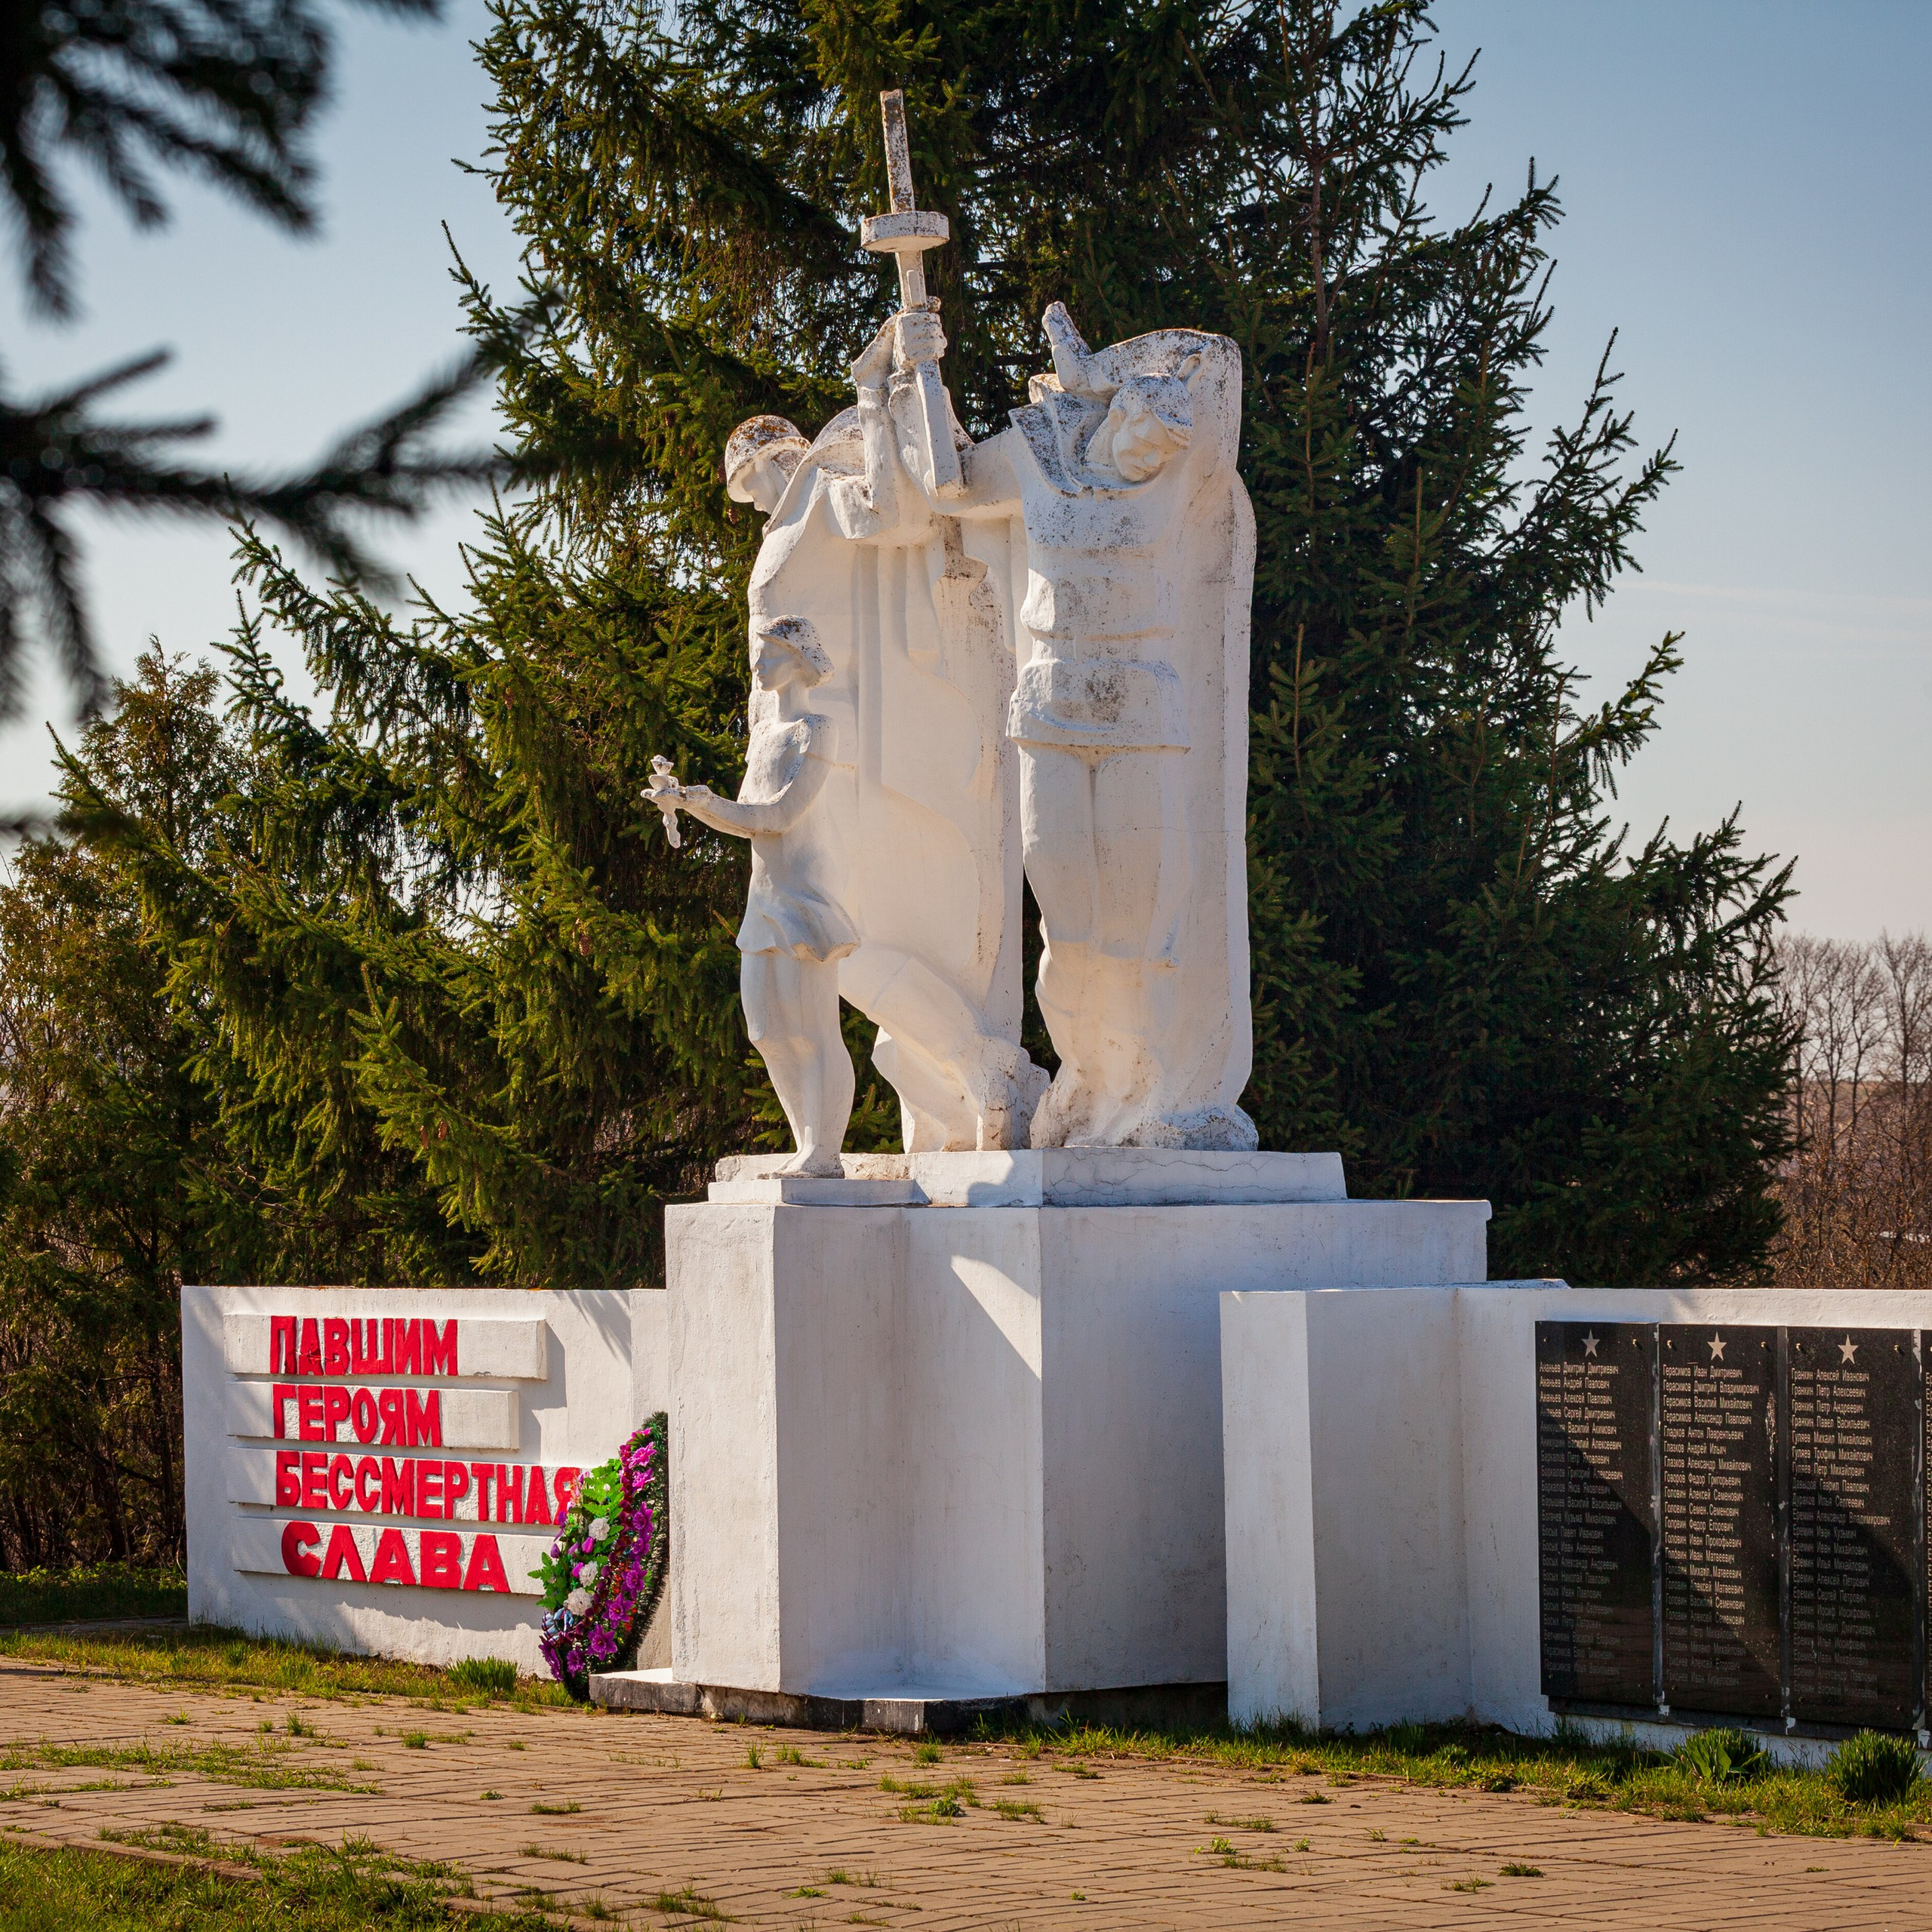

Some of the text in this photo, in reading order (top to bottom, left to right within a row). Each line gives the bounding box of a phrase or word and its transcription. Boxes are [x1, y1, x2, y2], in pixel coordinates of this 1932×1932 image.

[270, 1316, 457, 1376] ПАВШИМ
[1663, 1364, 1742, 1379] Герасимов Иван Дмитриевич
[1817, 1369, 1839, 1381] Алексей
[1842, 1370, 1869, 1382] Иванович
[1564, 1377, 1583, 1389] Андрей
[1585, 1377, 1610, 1389] Павлович
[1663, 1380, 1758, 1395] Герасимов Дмитрий Владимирович
[1564, 1392, 1585, 1403] Алексей
[1587, 1392, 1612, 1404] Павлович
[1817, 1385, 1830, 1398] Петр
[1832, 1386, 1866, 1397] Алексеевич
[1663, 1395, 1752, 1409] Герасимов Василий Михайлович
[1817, 1401, 1830, 1414] Петр
[1833, 1401, 1863, 1415] Андреевич
[273, 1384, 441, 1447] ГЕРОЯМ
[1564, 1407, 1582, 1420] Сергей
[1663, 1411, 1752, 1426] Герасимов Александр Павлович
[1817, 1416, 1834, 1427] Павел
[1837, 1417, 1870, 1429] Васильевич
[1687, 1427, 1703, 1438] Антон
[1814, 1432, 1835, 1444] Михаил
[1838, 1432, 1872, 1445] Михайлович
[1687, 1442, 1706, 1455] Андрей
[1709, 1443, 1726, 1454] Ильич
[1838, 1448, 1872, 1461] Михайлович
[1687, 1457, 1715, 1472] Александр
[1718, 1459, 1751, 1471] Михайлович
[1814, 1463, 1827, 1477] Петр
[1831, 1464, 1864, 1476] Михайлович
[1708, 1473, 1741, 1487] Григорьевич
[276, 1451, 580, 1525] БЕССМЕРТНАЯ
[1689, 1488, 1710, 1500] Алексей
[1690, 1534, 1703, 1546] Иван
[282, 1521, 510, 1594] СЛАВА
[1690, 1549, 1703, 1561] Иван
